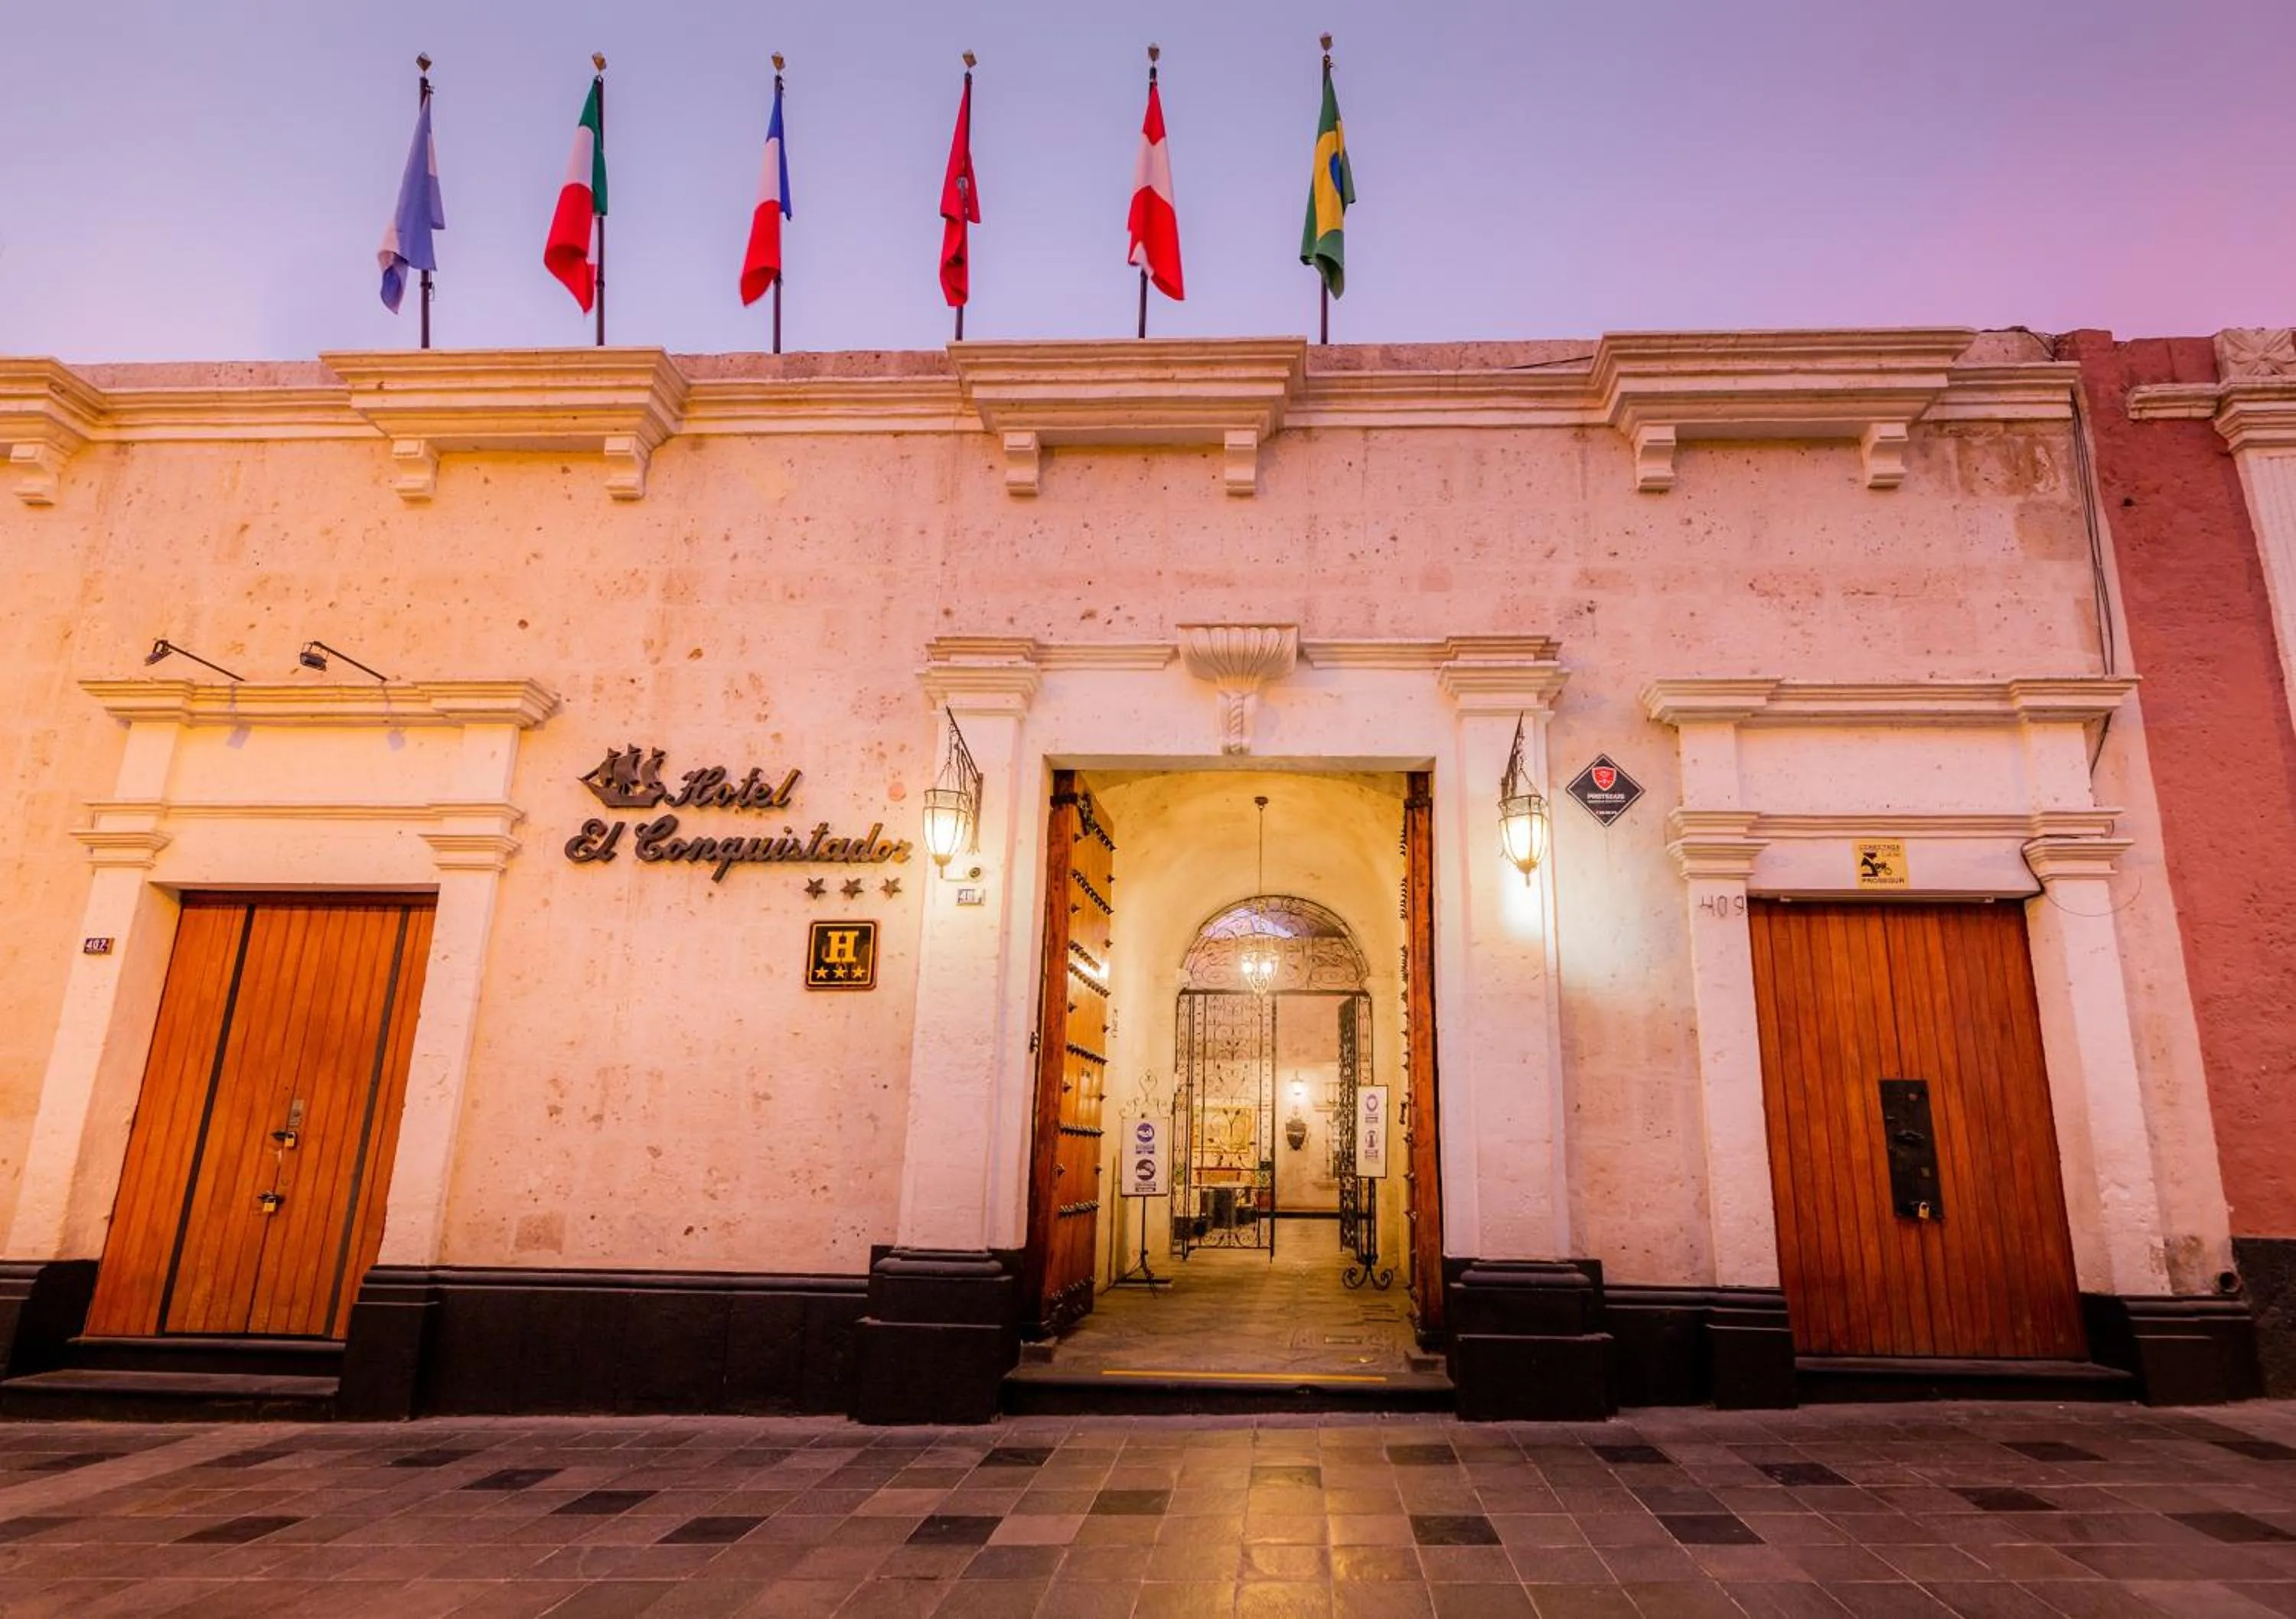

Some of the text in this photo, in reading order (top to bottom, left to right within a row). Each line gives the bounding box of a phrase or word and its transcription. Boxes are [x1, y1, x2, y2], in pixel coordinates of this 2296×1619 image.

[664, 765, 802, 809] Hotel
[565, 813, 913, 883] El Conquistador
[1699, 894, 1745, 917] 409
[825, 930, 859, 963] H
